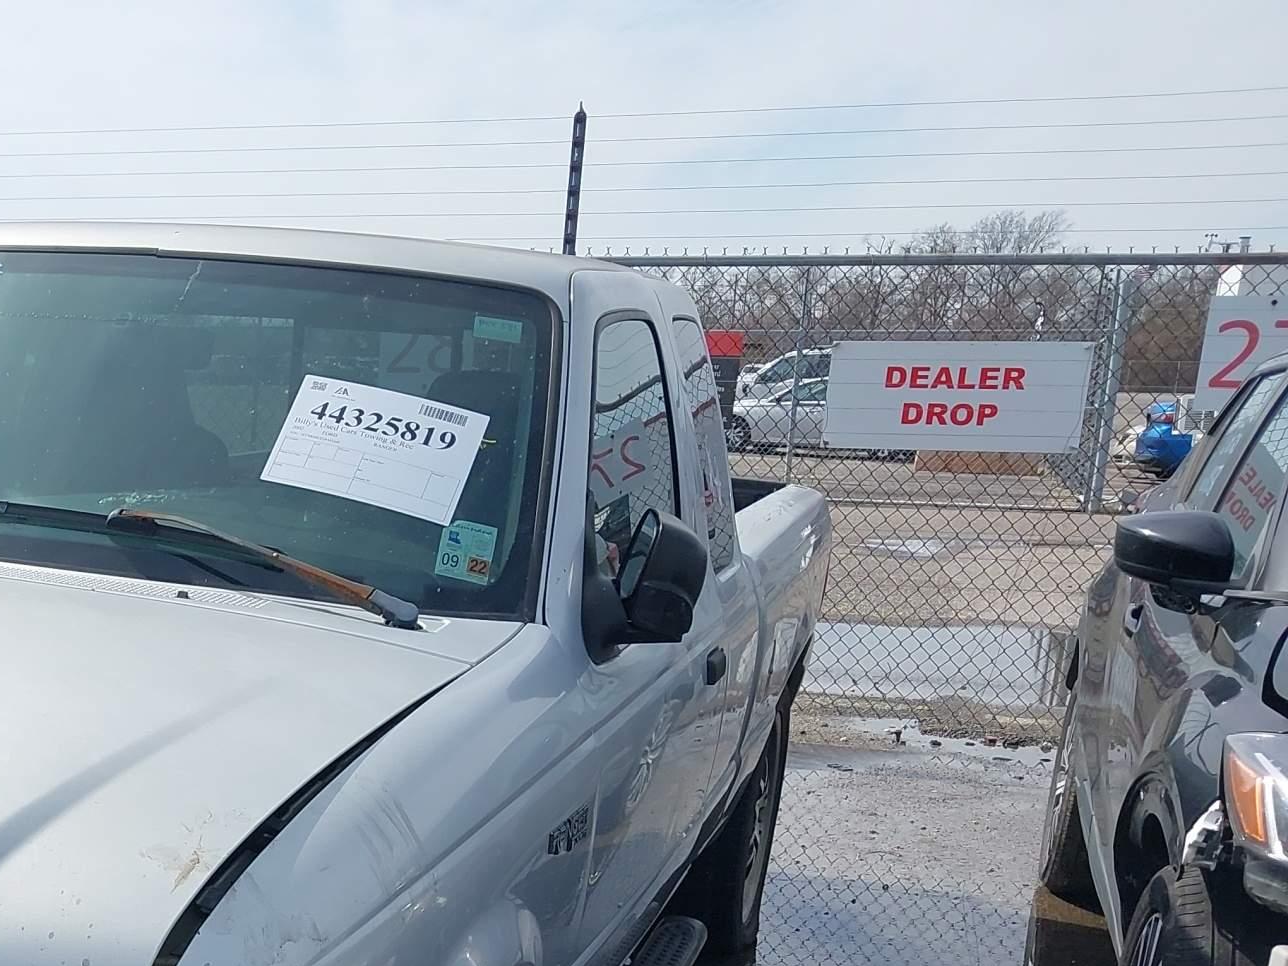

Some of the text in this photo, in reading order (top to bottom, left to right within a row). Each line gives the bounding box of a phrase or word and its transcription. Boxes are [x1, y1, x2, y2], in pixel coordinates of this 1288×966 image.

[1208, 318, 1288, 389] 2
[884, 366, 1026, 390] DEALER
[310, 401, 457, 450] 44325819
[900, 402, 998, 426] DROP
[320, 422, 339, 433] Used
[360, 431, 388, 444] Towing
[441, 552, 487, 575] 09 22
